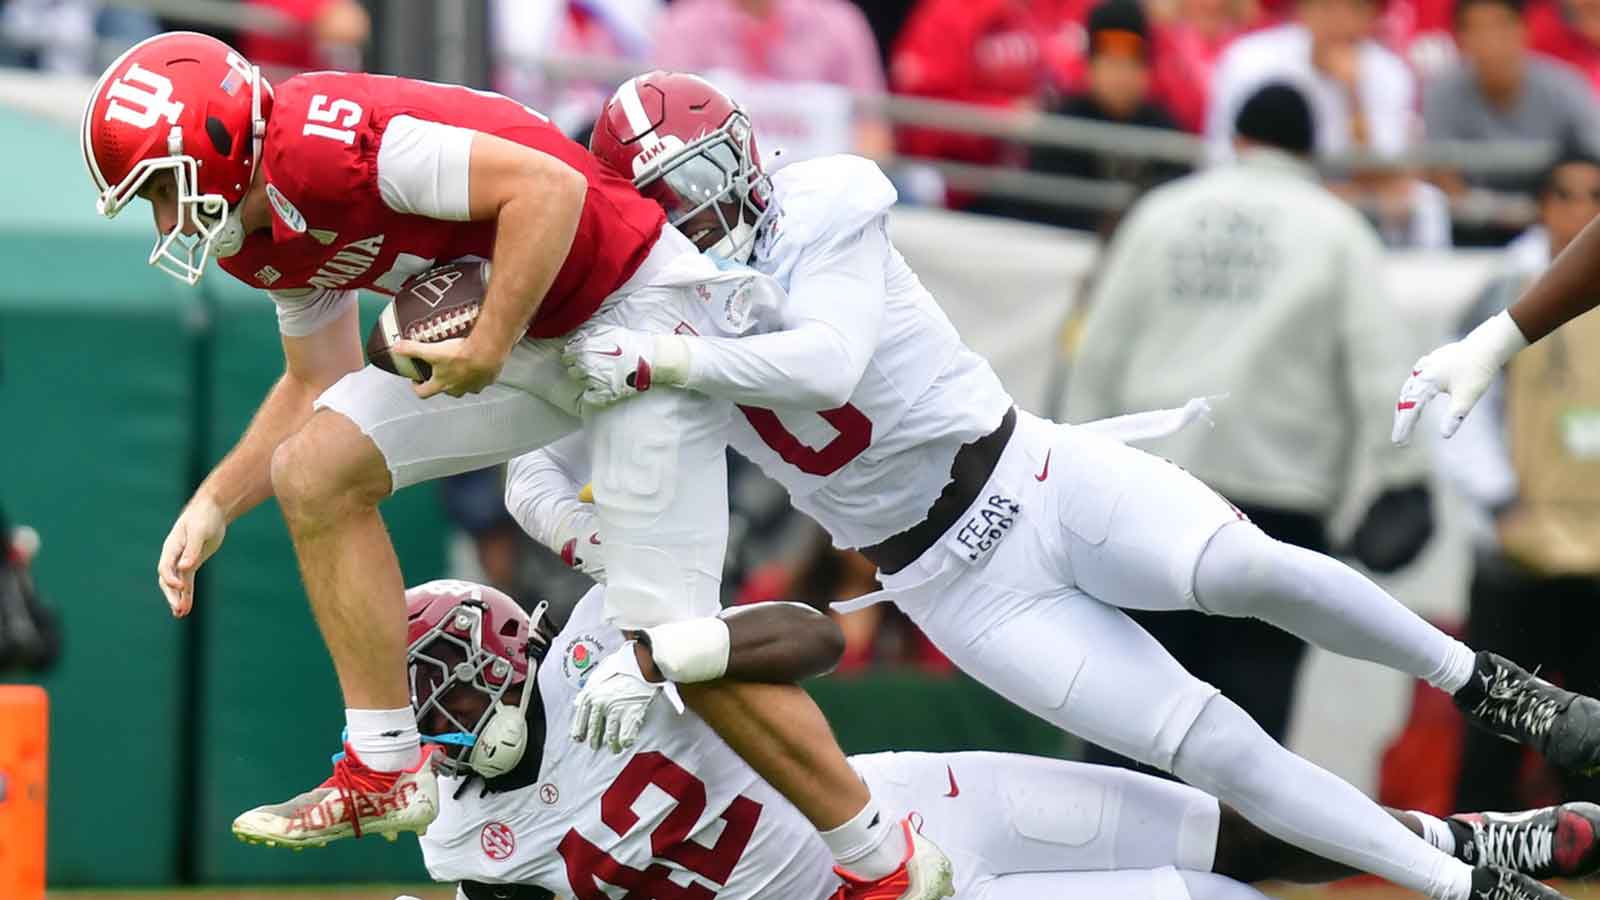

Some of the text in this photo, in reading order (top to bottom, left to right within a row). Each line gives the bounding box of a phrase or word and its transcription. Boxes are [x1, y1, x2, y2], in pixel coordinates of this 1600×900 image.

[105, 62, 185, 130] IU
[302, 94, 363, 145] 15
[639, 141, 666, 165] BAMA
[956, 494, 1012, 549] FEAR
[556, 751, 763, 900] 42
